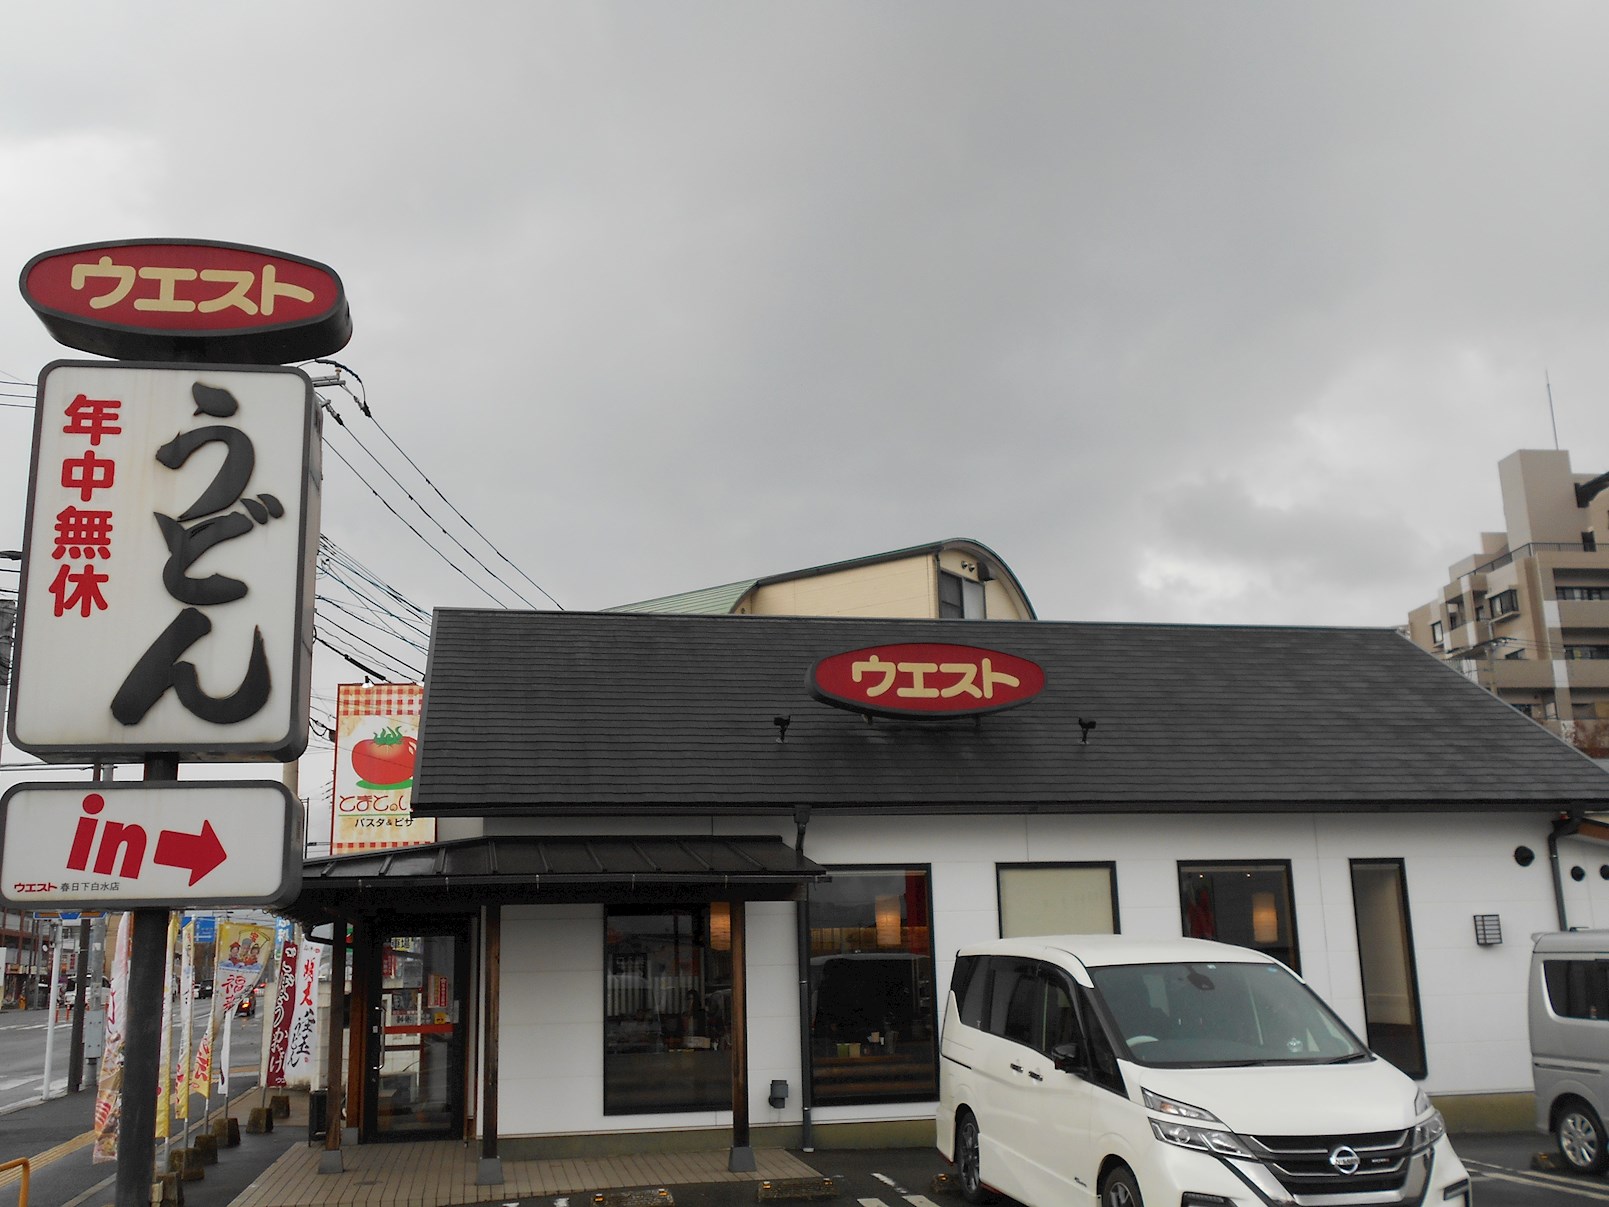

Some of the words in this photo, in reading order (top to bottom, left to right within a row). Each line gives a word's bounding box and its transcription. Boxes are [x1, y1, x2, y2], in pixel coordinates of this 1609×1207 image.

[70, 256, 315, 316] ウエスト
[49, 394, 122, 618] 年中無休
[110, 381, 285, 726] うどん
[851, 654, 1020, 699] ウエスト
[66, 793, 148, 880] in
[13, 882, 58, 893] ウエスト
[60, 881, 120, 892] 春日下白水店
